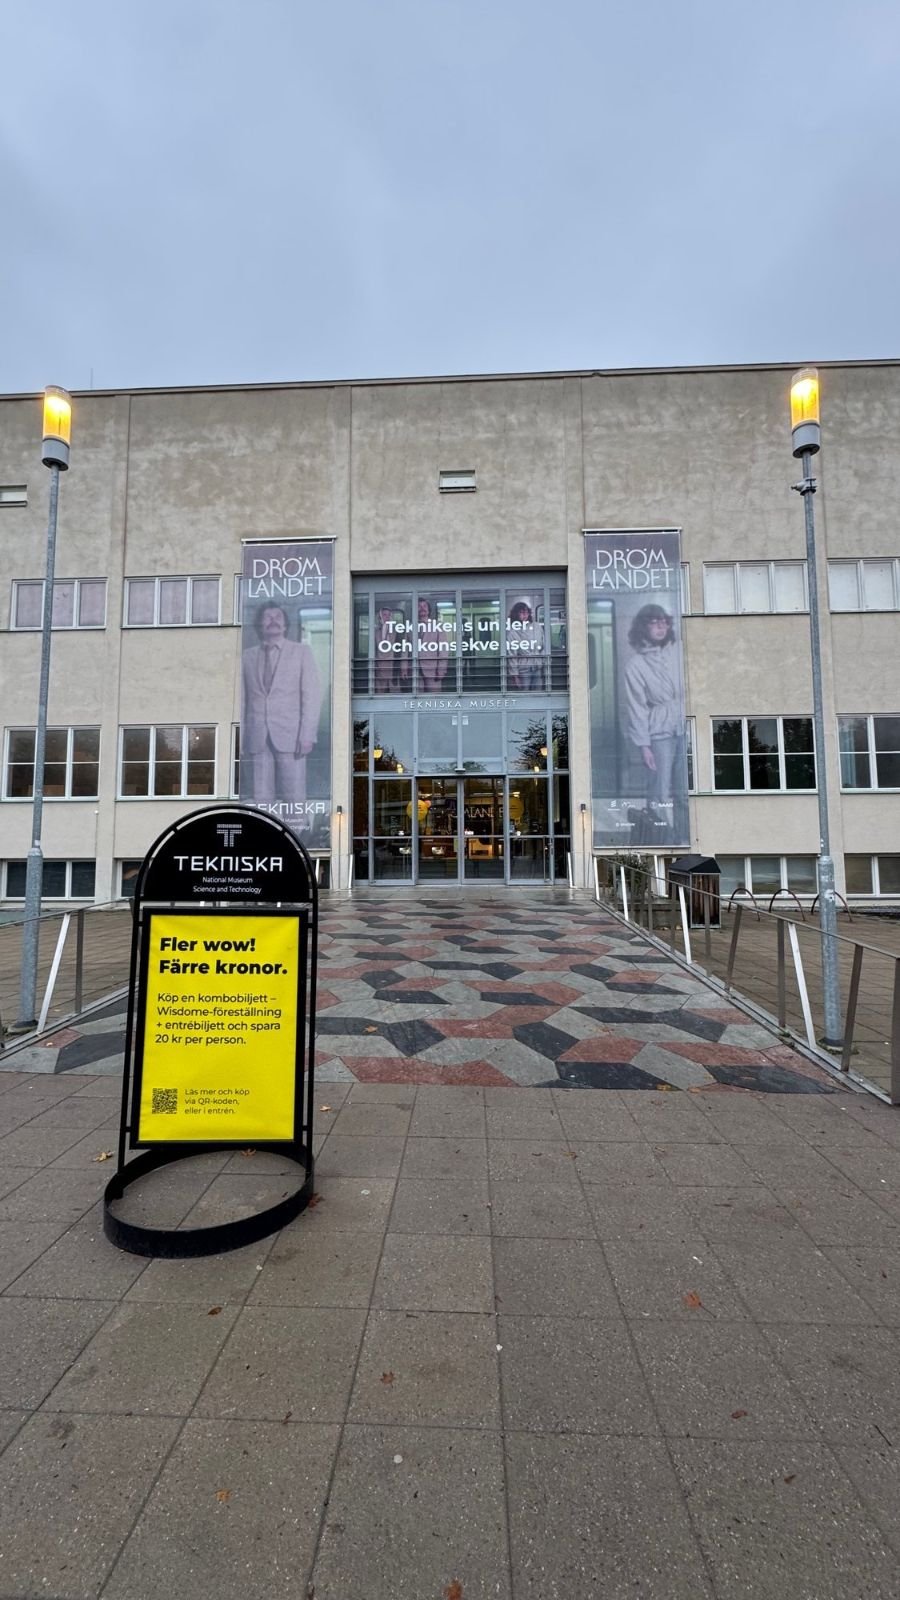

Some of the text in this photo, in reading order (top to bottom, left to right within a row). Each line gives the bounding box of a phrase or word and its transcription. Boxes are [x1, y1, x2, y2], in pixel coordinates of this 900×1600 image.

[596, 548, 669, 569] DRÖM
[253, 556, 322, 579] DRÖM
[592, 568, 674, 590] LANDET
[248, 576, 328, 598] LANDET
[478, 618, 533, 631] under.
[378, 639, 412, 653] Och
[404, 699, 518, 709] TEKNISKA MUSEET
[246, 802, 325, 814] EKNISKA
[173, 856, 283, 872] TEKNISKA
[202, 876, 253, 884] National Museum
[229, 886, 262, 894] Technology
[160, 937, 256, 952] Fler wow!
[159, 959, 288, 975] Färre kronor.
[157, 993, 178, 1005] Köp
[181, 995, 195, 1003] en
[198, 993, 268, 1005] kombobiljett
[157, 1006, 282, 1018] Wisdome-föreställning
[165, 1020, 225, 1032] entrébiljett
[227, 1021, 248, 1031] och
[250, 1022, 281, 1032] spara
[155, 1034, 246, 1046] 20 kr per person.
[234, 1088, 250, 1097] köp
[198, 1098, 240, 1106] QR-koden,
